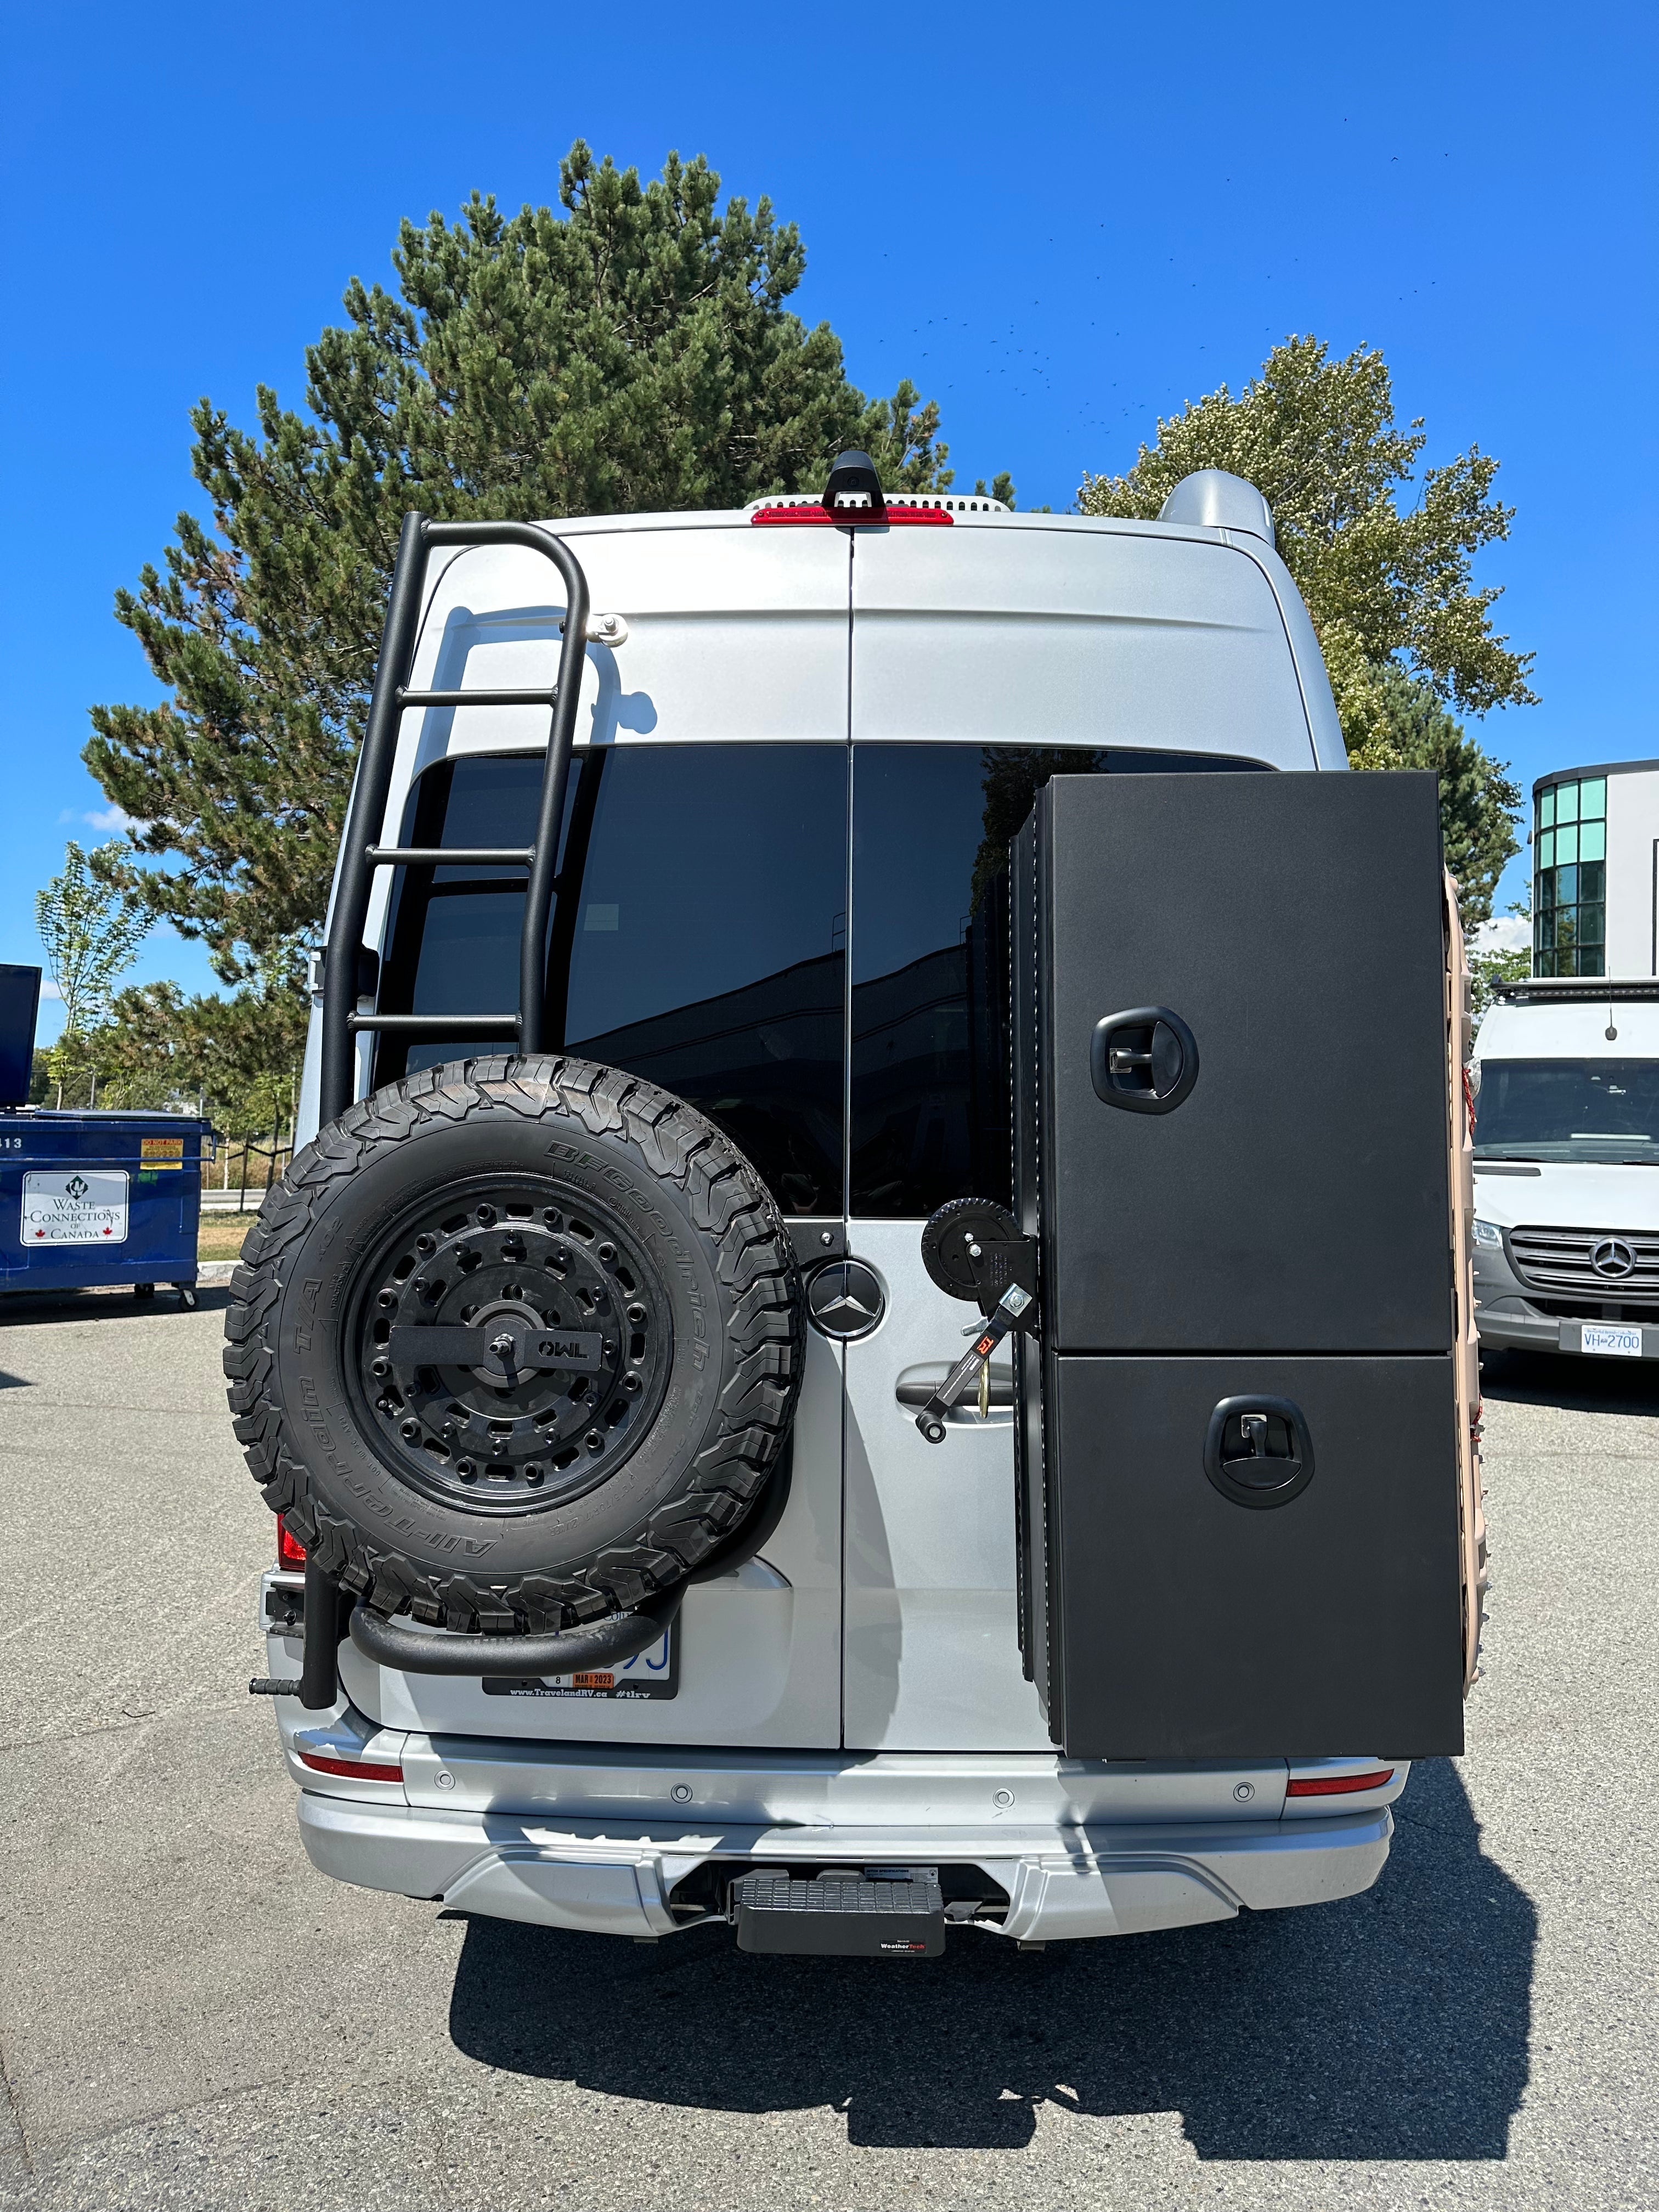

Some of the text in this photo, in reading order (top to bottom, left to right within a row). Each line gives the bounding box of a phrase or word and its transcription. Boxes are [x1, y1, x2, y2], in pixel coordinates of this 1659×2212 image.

[53, 1198, 95, 1210] WASTE
[30, 1210, 120, 1223] CONNECTIONS
[51, 1228, 99, 1239] CANADA
[544, 1141, 710, 1372] BFGoodrich
[330, 1273, 346, 1308] TRACTION
[1608, 1334, 1639, 1348] 2700
[539, 1341, 589, 1359] OWL
[575, 1675, 589, 1684] MAR
[594, 1675, 611, 1684] 2023
[510, 1689, 651, 1699] www.TravelandRV.ca #tlrv
